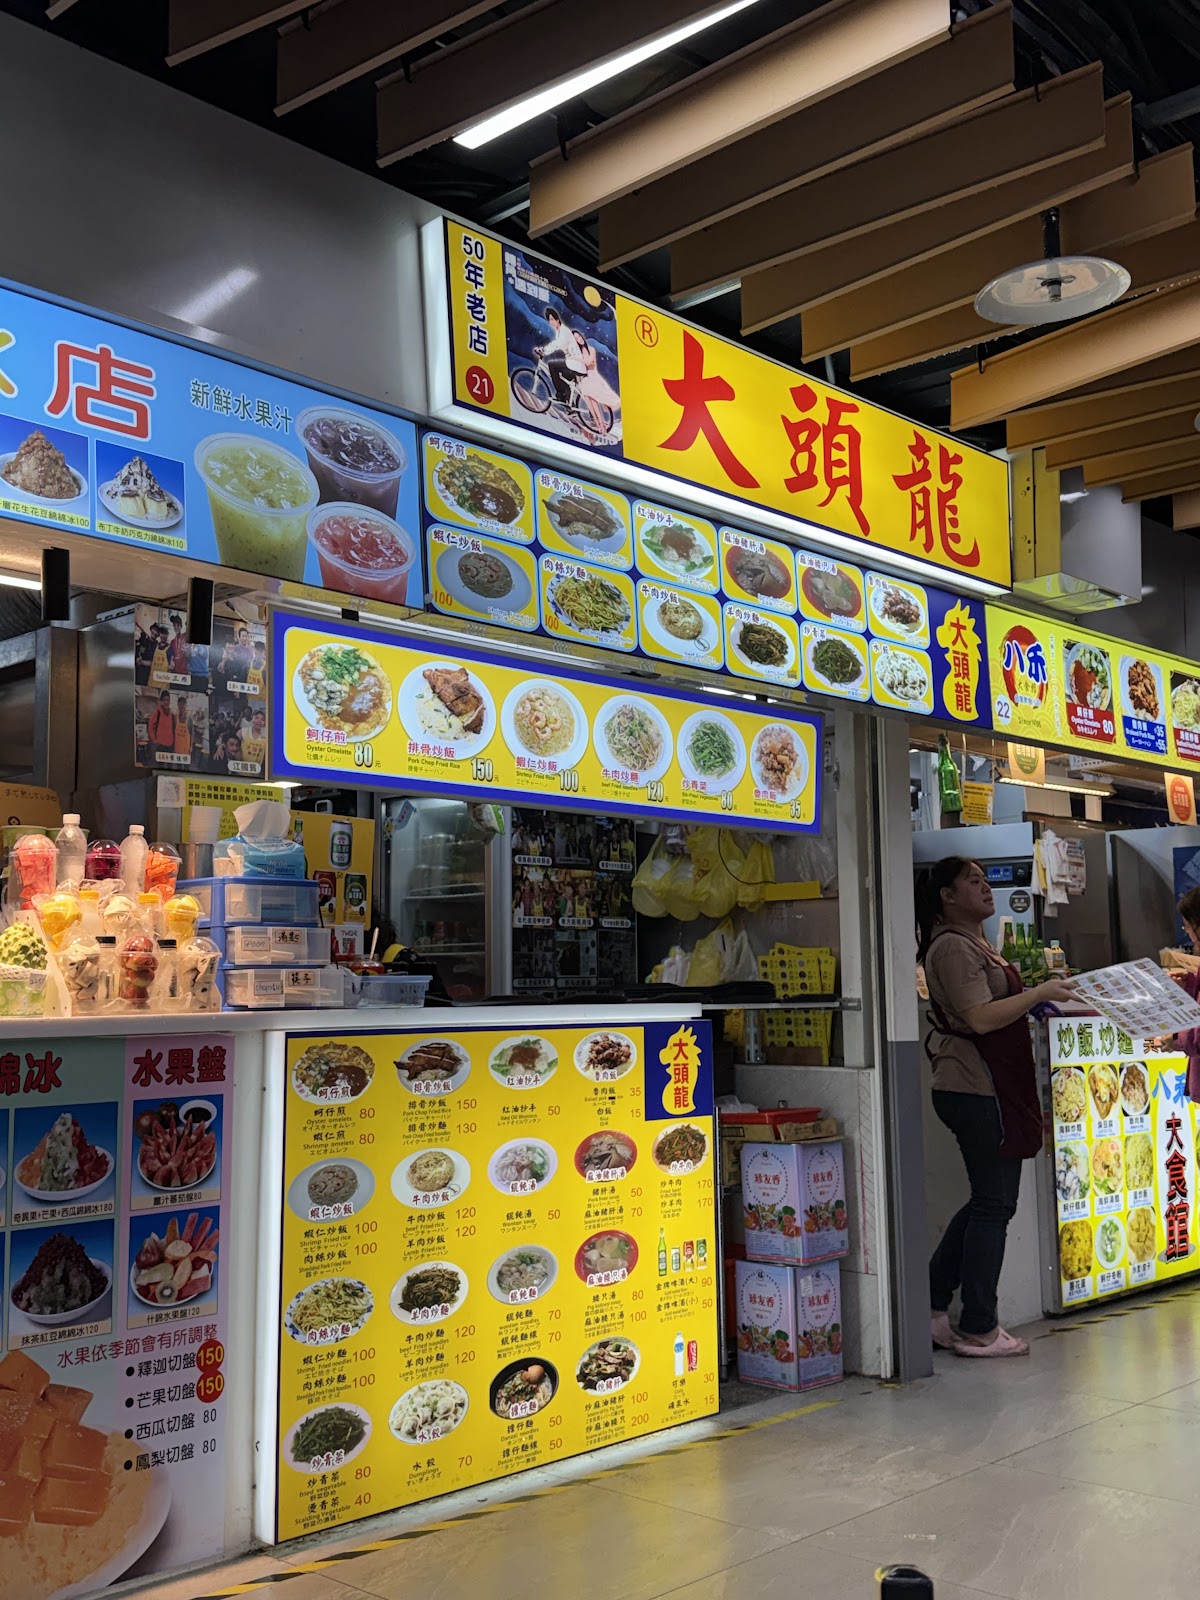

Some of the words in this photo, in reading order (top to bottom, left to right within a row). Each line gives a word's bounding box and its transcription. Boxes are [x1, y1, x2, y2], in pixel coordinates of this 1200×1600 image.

[463, 235, 487, 355] 50年老店
[472, 373, 489, 398] 21
[192, 380, 292, 433] 新鮮水果汁
[428, 436, 466, 458] 蚵仔煎
[659, 330, 980, 567] 大頭龍
[541, 474, 583, 498] 排骨炒飯
[433, 530, 482, 553] 蝦仁炒飯
[434, 590, 452, 606] 100
[642, 584, 678, 604] 牛肉炒飯
[545, 614, 559, 630] 100
[873, 643, 890, 655] 水餃
[950, 616, 973, 715] 大頭龍
[997, 701, 1010, 719] 22
[1102, 720, 1114, 735] 80
[306, 728, 347, 745] 蚵仔煎
[306, 744, 326, 753] Oyster
[354, 742, 373, 768] 80
[408, 741, 455, 759] 排骨炒飯
[471, 757, 493, 782] 150
[516, 756, 558, 772] 蝦仁炒飯
[559, 769, 579, 792] 100
[602, 768, 639, 782] 牛肉炒麵
[647, 780, 664, 802] 120
[682, 779, 708, 791] 炒青菜
[721, 790, 733, 810] 80
[790, 799, 801, 819] 35
[291, 972, 311, 985] 筷子
[132, 1045, 227, 1087] 水果盤
[672, 1037, 689, 1109] 大頭龍
[507, 1075, 541, 1086] 紅油抄手
[594, 1070, 617, 1081] 魯肉飯
[318, 1087, 351, 1100] 蚵仔煎
[413, 1081, 452, 1094] 排骨炒飯
[593, 1086, 616, 1096] 魯肉飯
[629, 1087, 641, 1096] 35
[408, 1098, 447, 1109] 排骨炒飯
[457, 1098, 477, 1109] 150
[502, 1103, 537, 1114] 紅油抄手
[547, 1105, 561, 1115] 50
[597, 1107, 612, 1115] 白飯
[306, 1117, 327, 1126] Oyster
[328, 1115, 352, 1123] omelets
[313, 1106, 346, 1117] 蚵仔煎
[359, 1107, 376, 1119] 80
[302, 1122, 356, 1132] オイスターオムレツ
[408, 1121, 447, 1133] 排骨炒麵
[456, 1122, 477, 1134] 130
[313, 1130, 346, 1141] 蝦仁煎
[359, 1133, 375, 1145] 80
[309, 1147, 348, 1156] エビオムレツ
[586, 1167, 626, 1183] 麻油豬肝湯
[592, 1185, 616, 1195] 豬肝湯
[630, 1187, 643, 1198] 50
[660, 1178, 682, 1188] 炒牛肉
[697, 1178, 713, 1190] 170
[1165, 1112, 1190, 1262] 大食館
[660, 1199, 683, 1209] 炒羊肉
[697, 1197, 713, 1208] 170
[407, 1211, 446, 1224] 牛肉炒飯
[456, 1207, 477, 1219] 120
[506, 1209, 532, 1221] 餛飩湯
[547, 1209, 561, 1219] 50
[584, 1205, 624, 1218] 麻油豬肝湯
[631, 1206, 643, 1217] 70
[303, 1224, 348, 1238] 蝦仁炒飯
[355, 1220, 378, 1234] 100
[406, 1234, 446, 1248] 羊肉炒飯
[456, 1225, 476, 1237] 120
[299, 1238, 322, 1247] Shrimp
[304, 1250, 348, 1264] 肉絲炒飯
[354, 1242, 378, 1255] 100
[656, 1275, 699, 1292] 金牌啤酒(大)
[701, 1276, 713, 1288] 90
[632, 1289, 644, 1301] 80
[656, 1297, 699, 1313] 金牌啤酒(小)
[701, 1298, 713, 1310] 50
[146, 1307, 200, 1324] 什錦水果盤120
[506, 1309, 533, 1322] 餛飩麵
[548, 1309, 561, 1320] 70
[629, 1310, 647, 1323] 100
[405, 1329, 446, 1344] 牛肉炒麵
[454, 1325, 476, 1339] 120
[548, 1331, 562, 1343] 70
[57, 1324, 218, 1368] 水果依季節會有所調整
[137, 1351, 196, 1378] 釋迦切盤
[198, 1345, 224, 1367] 150
[303, 1348, 348, 1365] 蝦仁炒麵
[352, 1347, 376, 1362] 100
[405, 1353, 445, 1368] 羊肉炒麵
[454, 1350, 476, 1364] 120
[302, 1375, 347, 1391] 肉絲炒麵
[352, 1373, 376, 1389] 100
[671, 1378, 687, 1389] 可樂
[703, 1372, 715, 1384] 30
[137, 1382, 196, 1409] 芒果切盤
[198, 1374, 224, 1396] 150
[584, 1394, 625, 1412] 炒麻油豬肝
[630, 1391, 649, 1405] 100
[704, 1394, 715, 1406] 15
[136, 1412, 196, 1440] 西瓜切盤
[203, 1408, 217, 1424] 80
[549, 1415, 562, 1428] 50
[631, 1413, 649, 1427] 200
[549, 1438, 563, 1451] 50
[135, 1442, 195, 1472] 鳳梨切盤
[202, 1438, 216, 1454] 80
[412, 1457, 436, 1471] 水餃
[457, 1455, 473, 1468] 70
[307, 1471, 340, 1489] 炒青菜
[355, 1466, 371, 1480] 80
[355, 1492, 372, 1506] 40
